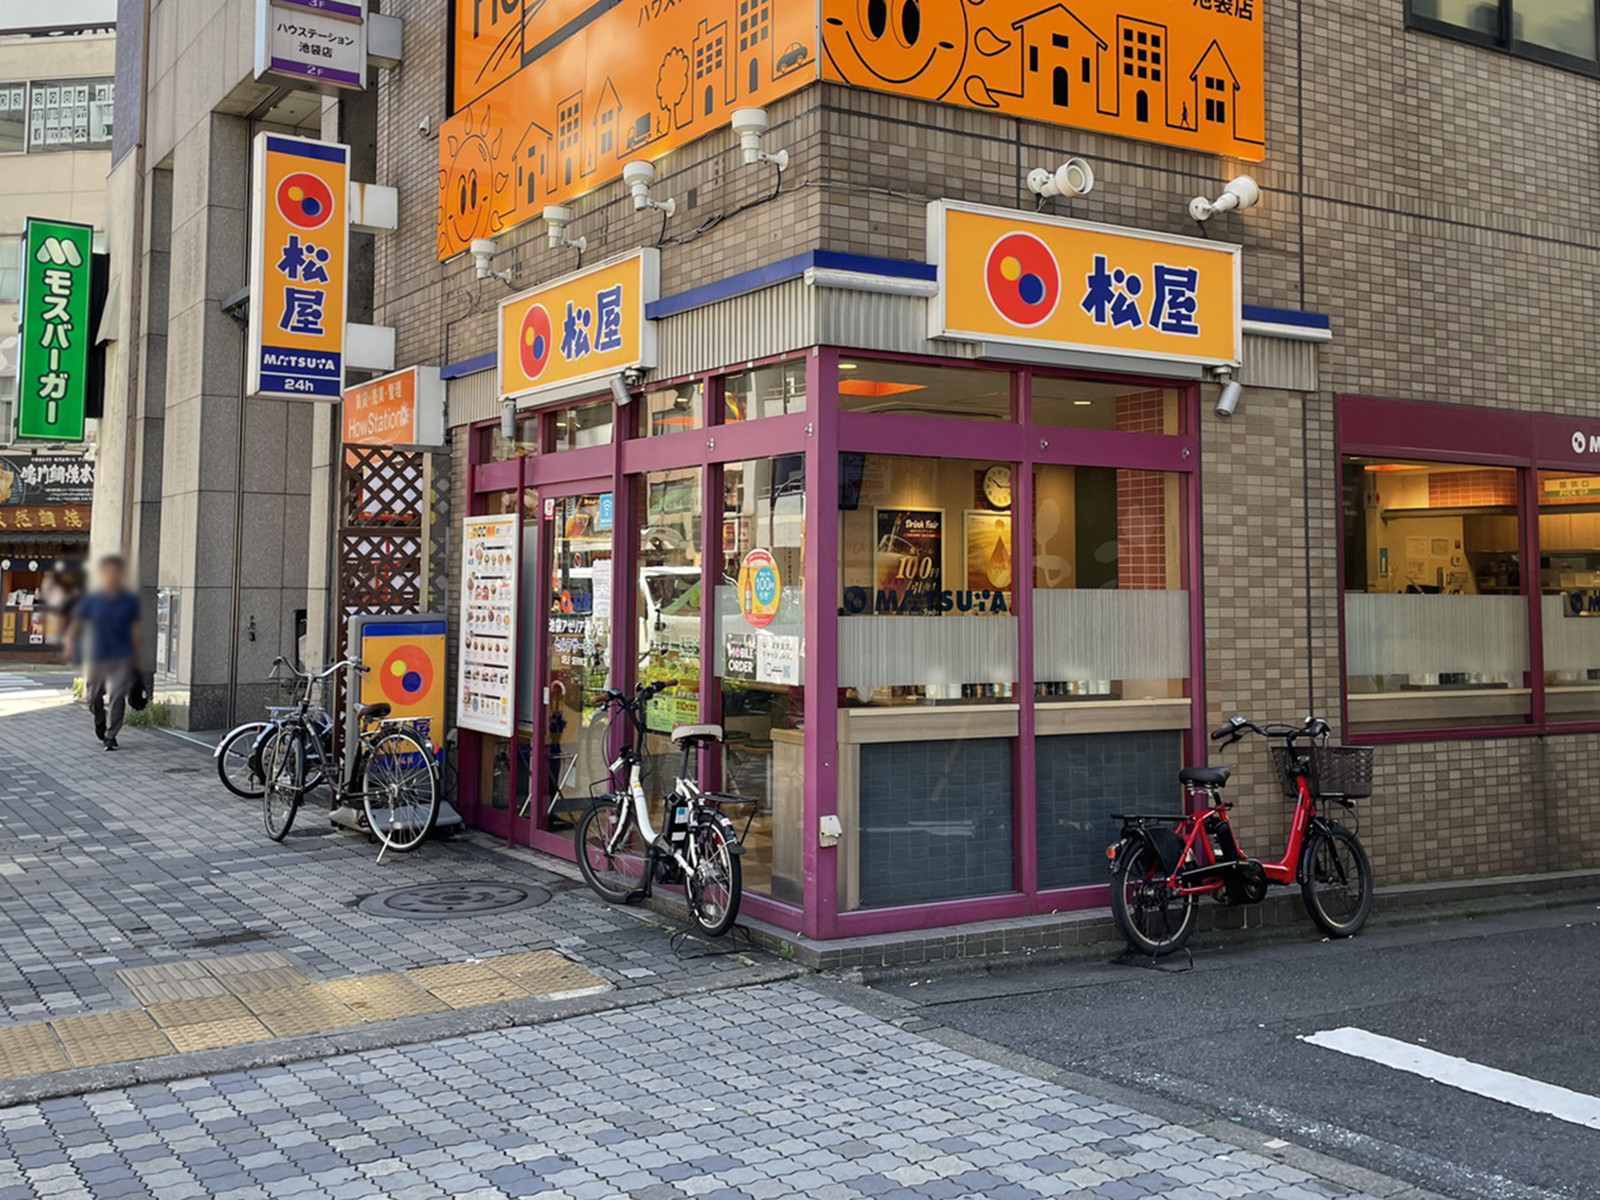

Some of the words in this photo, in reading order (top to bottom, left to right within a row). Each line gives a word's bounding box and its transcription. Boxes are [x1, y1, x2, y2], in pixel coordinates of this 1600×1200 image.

[277, 23, 354, 46] ハウステーション
[299, 41, 332, 58] 池袋店
[306, 64, 325, 76] 2F
[277, 235, 329, 336] 松屋
[1080, 254, 1199, 336] 松屋
[559, 284, 622, 361] 松屋
[38, 269, 72, 424] モスバーガー
[263, 354, 335, 370] MATSUYA
[284, 378, 314, 392] 24h
[20, 463, 95, 486] 鳴門鯛焼本
[905, 519, 924, 529] Drink
[926, 520, 939, 529] Fair
[727, 643, 754, 659] MOBILE
[728, 659, 754, 673] ORDER
